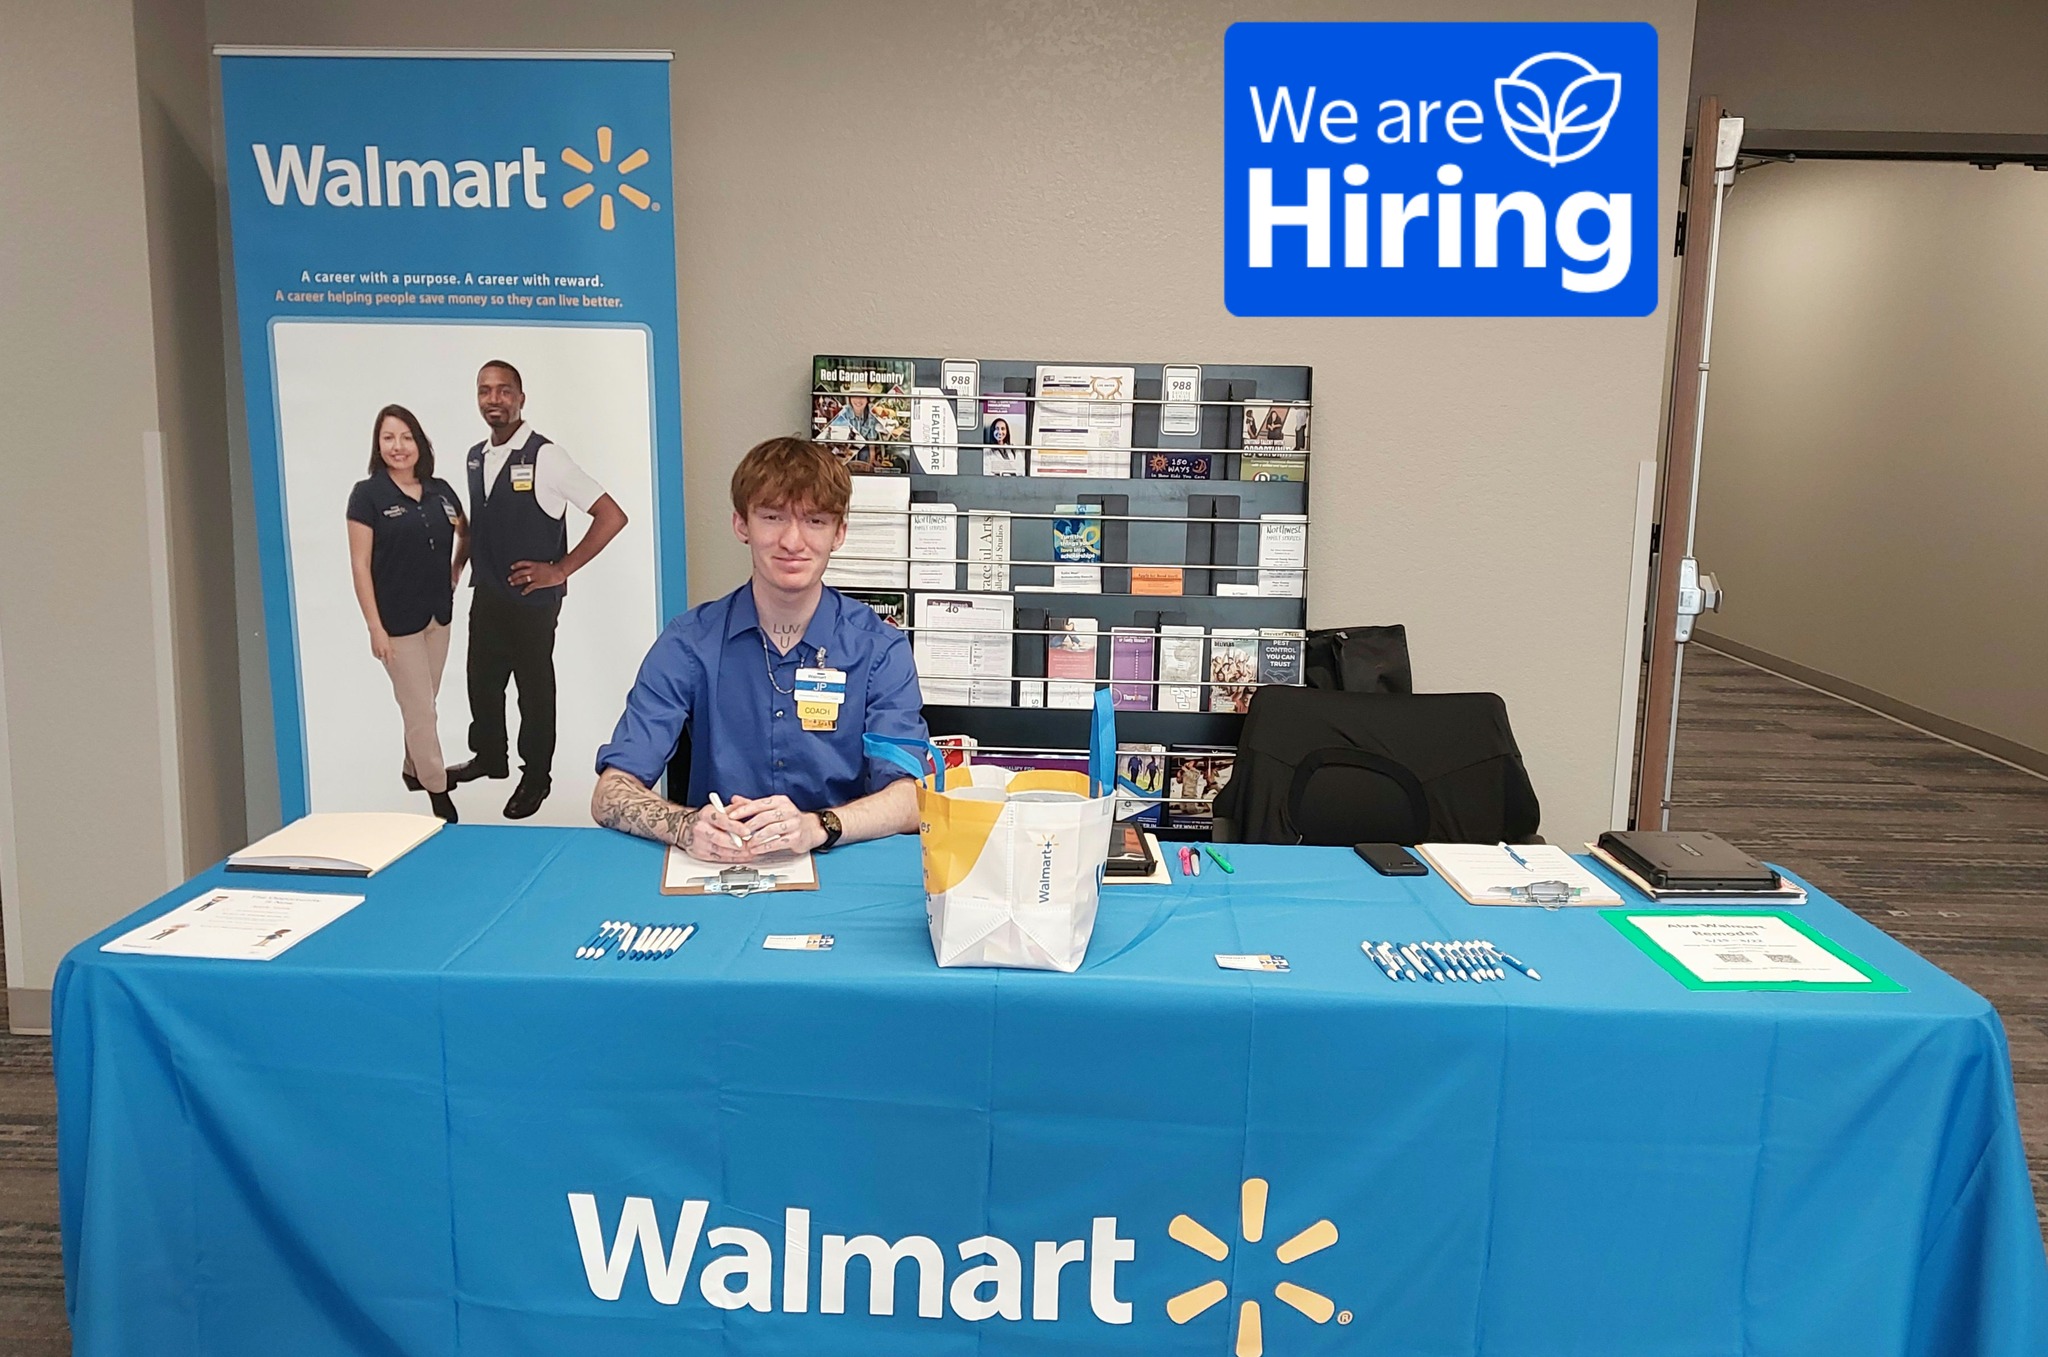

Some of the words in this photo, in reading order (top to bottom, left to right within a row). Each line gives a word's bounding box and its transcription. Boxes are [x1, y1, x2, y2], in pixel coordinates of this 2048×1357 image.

[251, 143, 547, 209] Walmart
[301, 270, 311, 283] A
[315, 272, 355, 283] career
[360, 271, 388, 284] with
[392, 274, 400, 284] a
[404, 274, 461, 288] purpose.
[464, 273, 474, 285] A
[478, 275, 518, 286] career
[523, 273, 550, 287] with
[554, 275, 604, 288] reward.
[275, 289, 284, 302] A
[287, 291, 325, 302] career
[328, 290, 372, 306] helping
[375, 291, 416, 306] people
[419, 294, 444, 304] save
[448, 293, 487, 307] money
[491, 294, 502, 305] so
[507, 293, 533, 308] they
[536, 295, 556, 306] can
[559, 294, 580, 307] live
[582, 294, 623, 308] better.
[820, 368, 838, 381] Red
[838, 369, 869, 383] Carpet
[869, 370, 905, 386] Country
[951, 375, 971, 385] 988
[1172, 381, 1192, 390] 988
[1171, 458, 1188, 466] 150
[980, 515, 992, 544] Arts
[995, 524, 1004, 553] Studios
[866, 602, 898, 616] untry
[773, 623, 801, 635] LUV
[780, 635, 791, 649] U
[813, 682, 828, 691] JP
[805, 706, 831, 716] COACH
[567, 1192, 1136, 1326] Walmart
